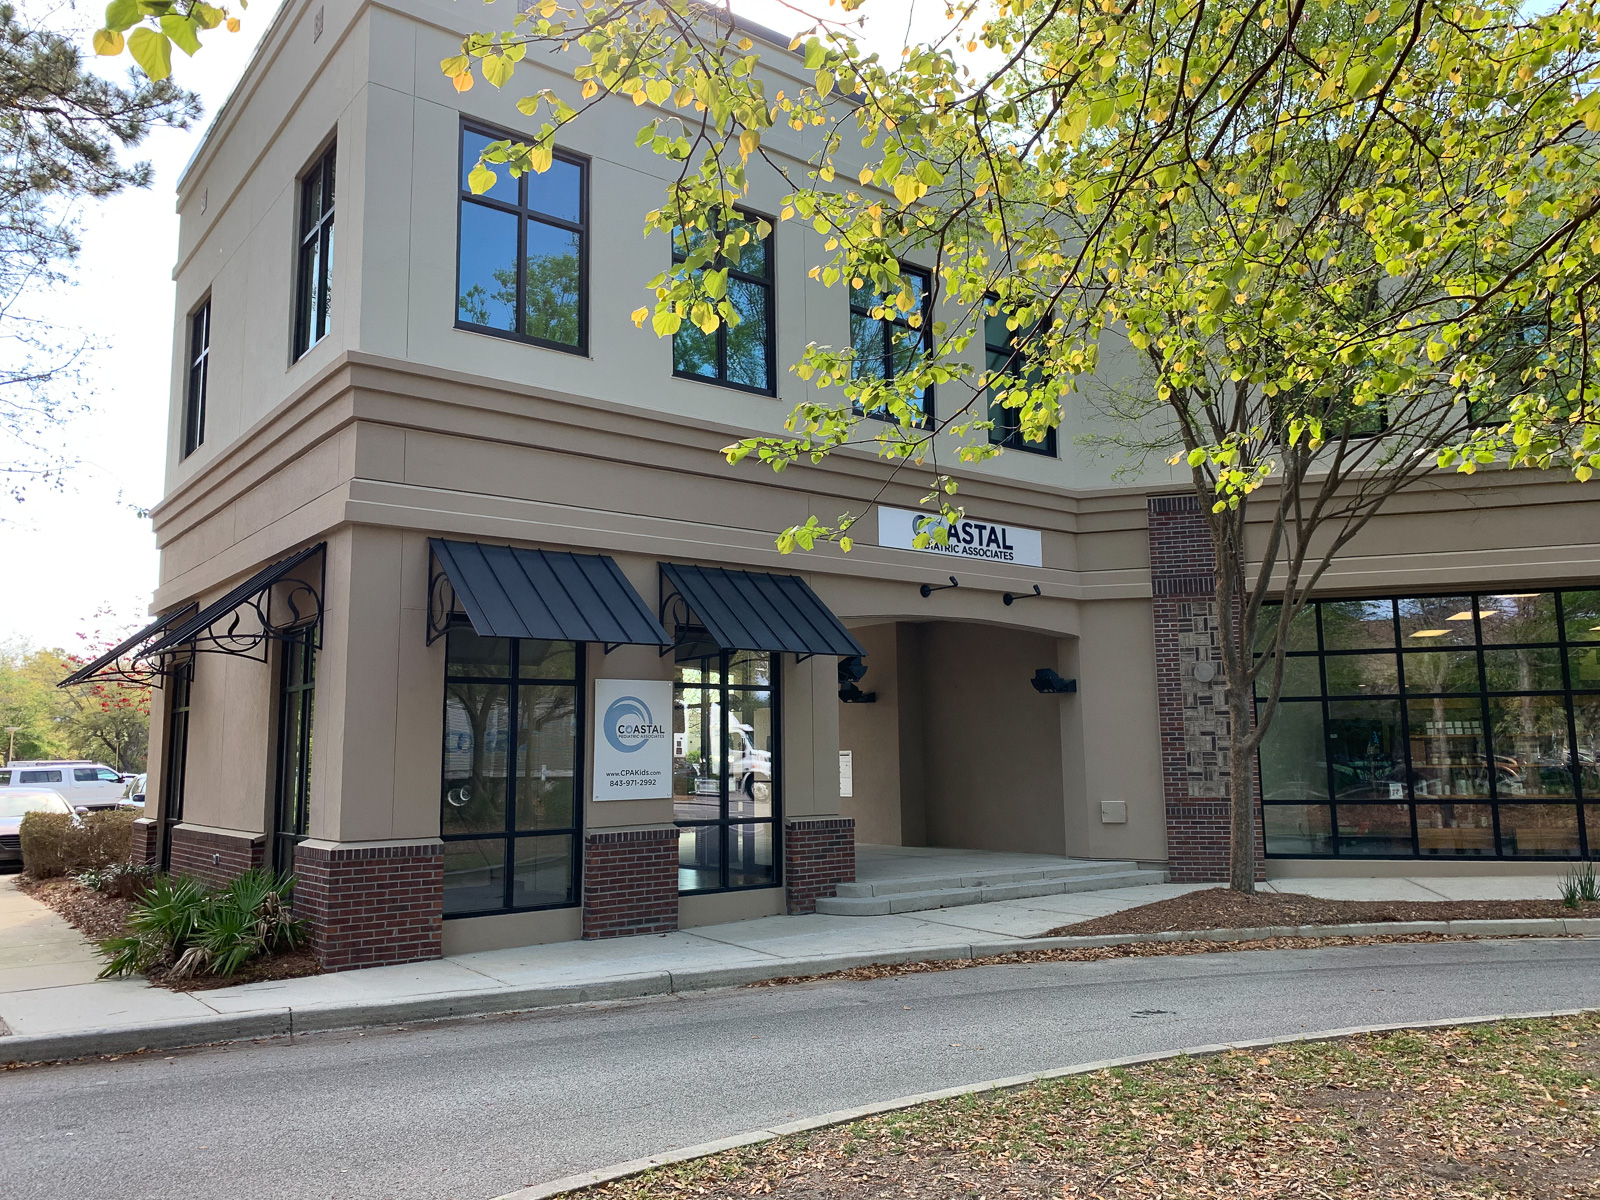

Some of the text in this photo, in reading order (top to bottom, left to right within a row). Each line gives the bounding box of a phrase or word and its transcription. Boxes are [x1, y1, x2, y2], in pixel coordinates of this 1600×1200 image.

[961, 546, 1014, 561] ASSOCIATES
[617, 724, 665, 734] COASTAL
[605, 768, 661, 777] www.CPAKids.com
[609, 779, 657, 787] 843-971-2992
